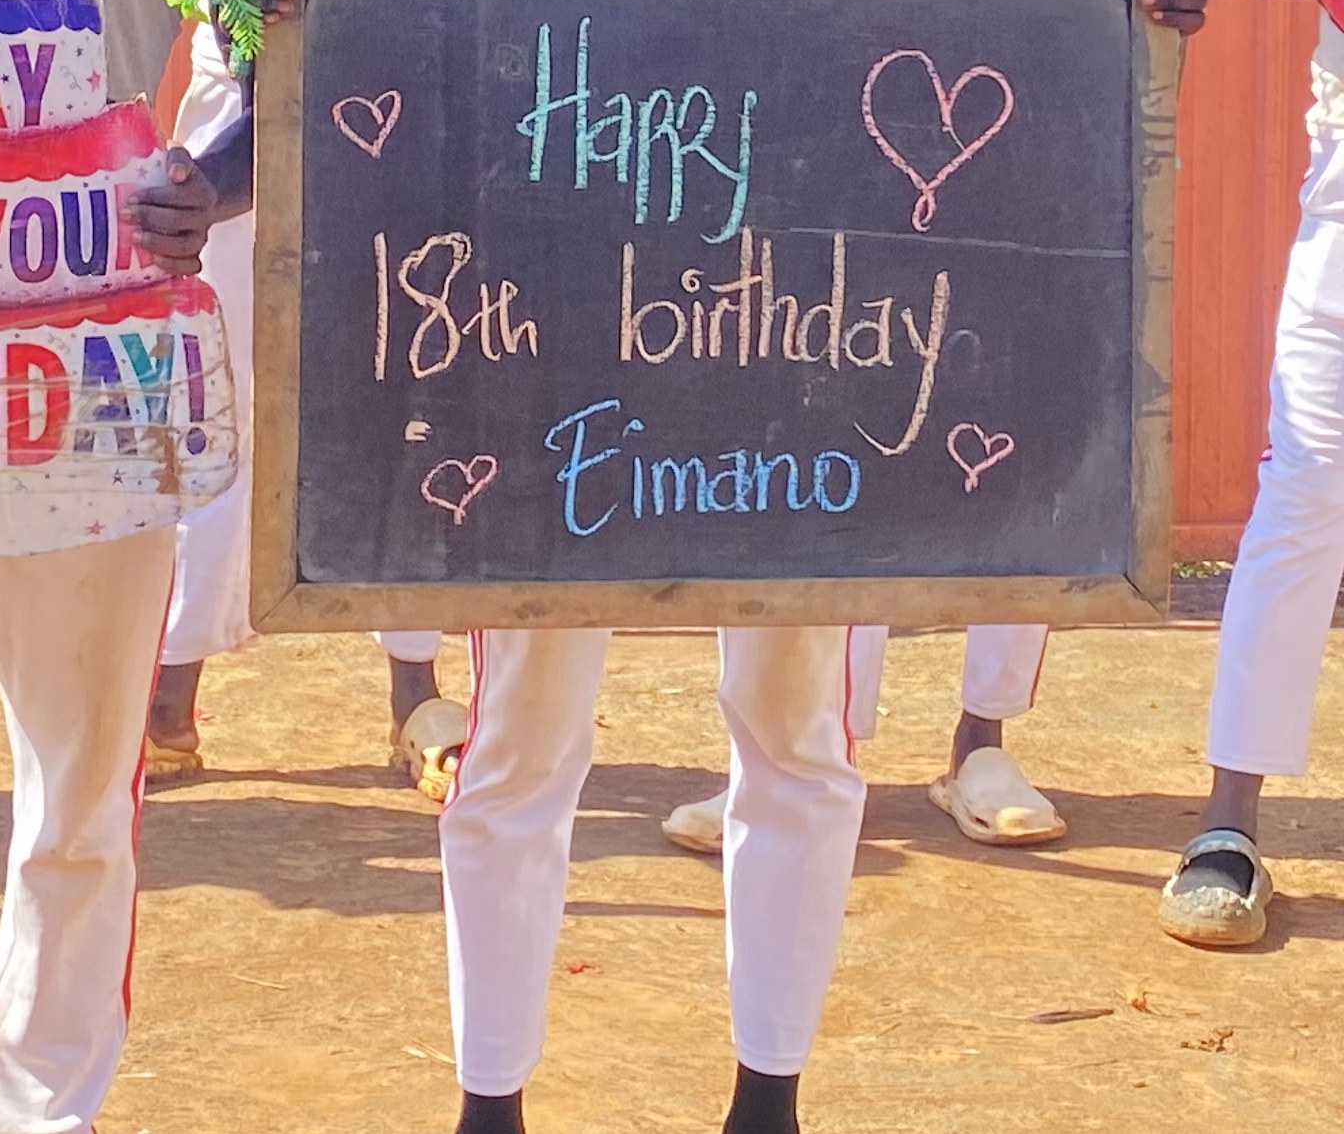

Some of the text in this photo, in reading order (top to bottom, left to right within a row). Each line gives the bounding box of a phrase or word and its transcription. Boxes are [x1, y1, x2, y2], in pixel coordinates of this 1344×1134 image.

[516, 16, 757, 245] Happy
[374, 225, 950, 456] 18th birthday
